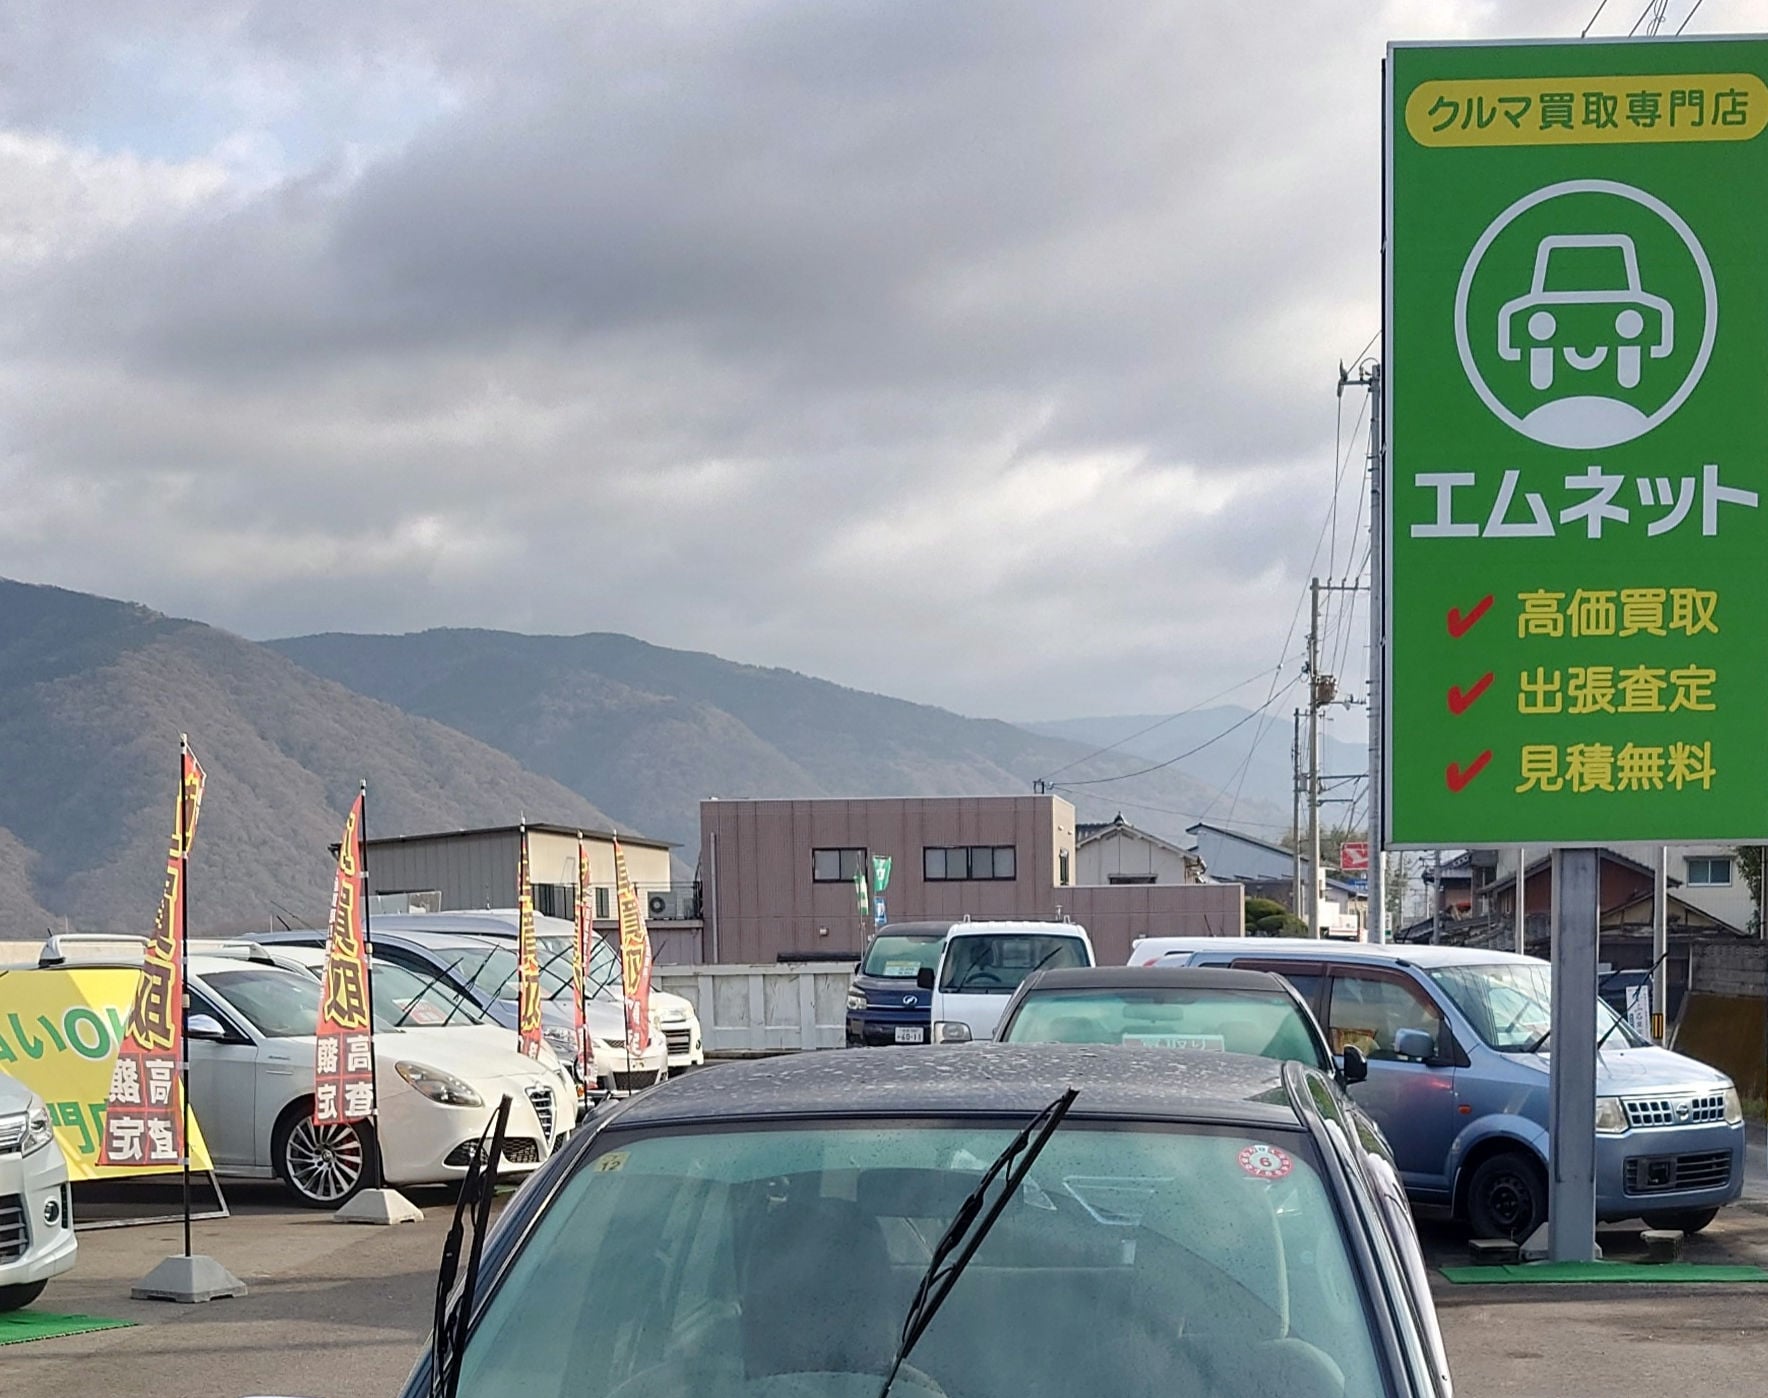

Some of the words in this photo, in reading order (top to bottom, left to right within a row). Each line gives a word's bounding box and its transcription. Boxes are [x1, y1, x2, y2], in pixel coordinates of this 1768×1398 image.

[1427, 88, 1750, 134] クルマ買取専門店
[1411, 464, 1759, 539] エムネット
[1516, 588, 1719, 639] 高価買取
[1516, 665, 1718, 715] 出張査定
[1515, 740, 1717, 794] 見積無料
[1259, 1156, 1272, 1167] 6
